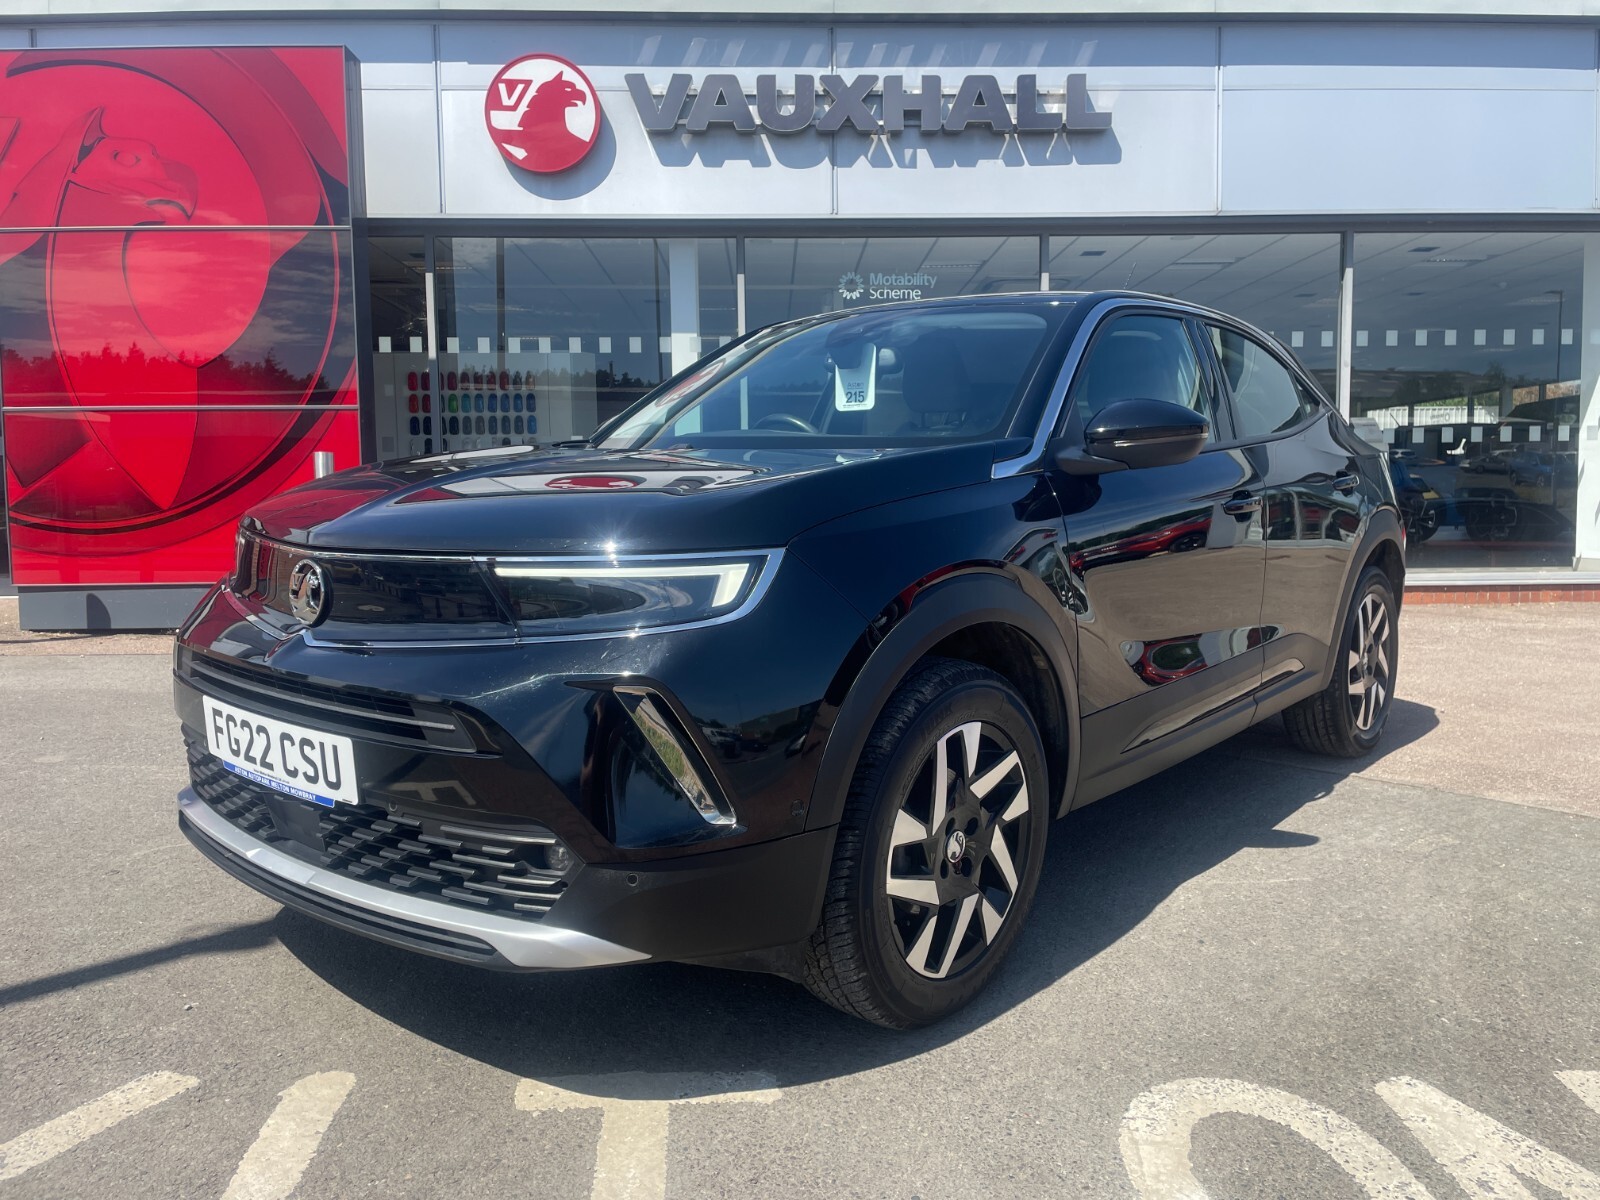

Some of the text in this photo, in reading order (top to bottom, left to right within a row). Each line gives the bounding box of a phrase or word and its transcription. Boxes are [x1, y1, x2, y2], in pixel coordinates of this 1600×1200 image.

[624, 73, 1112, 133] VAUXHALL
[869, 272, 937, 289] Motability
[869, 287, 922, 300] Scheme
[845, 391, 865, 404] 215
[212, 706, 342, 791] FG22 CSU
[271, 780, 290, 793] MELTON
[290, 785, 317, 801] MOWBRAY
